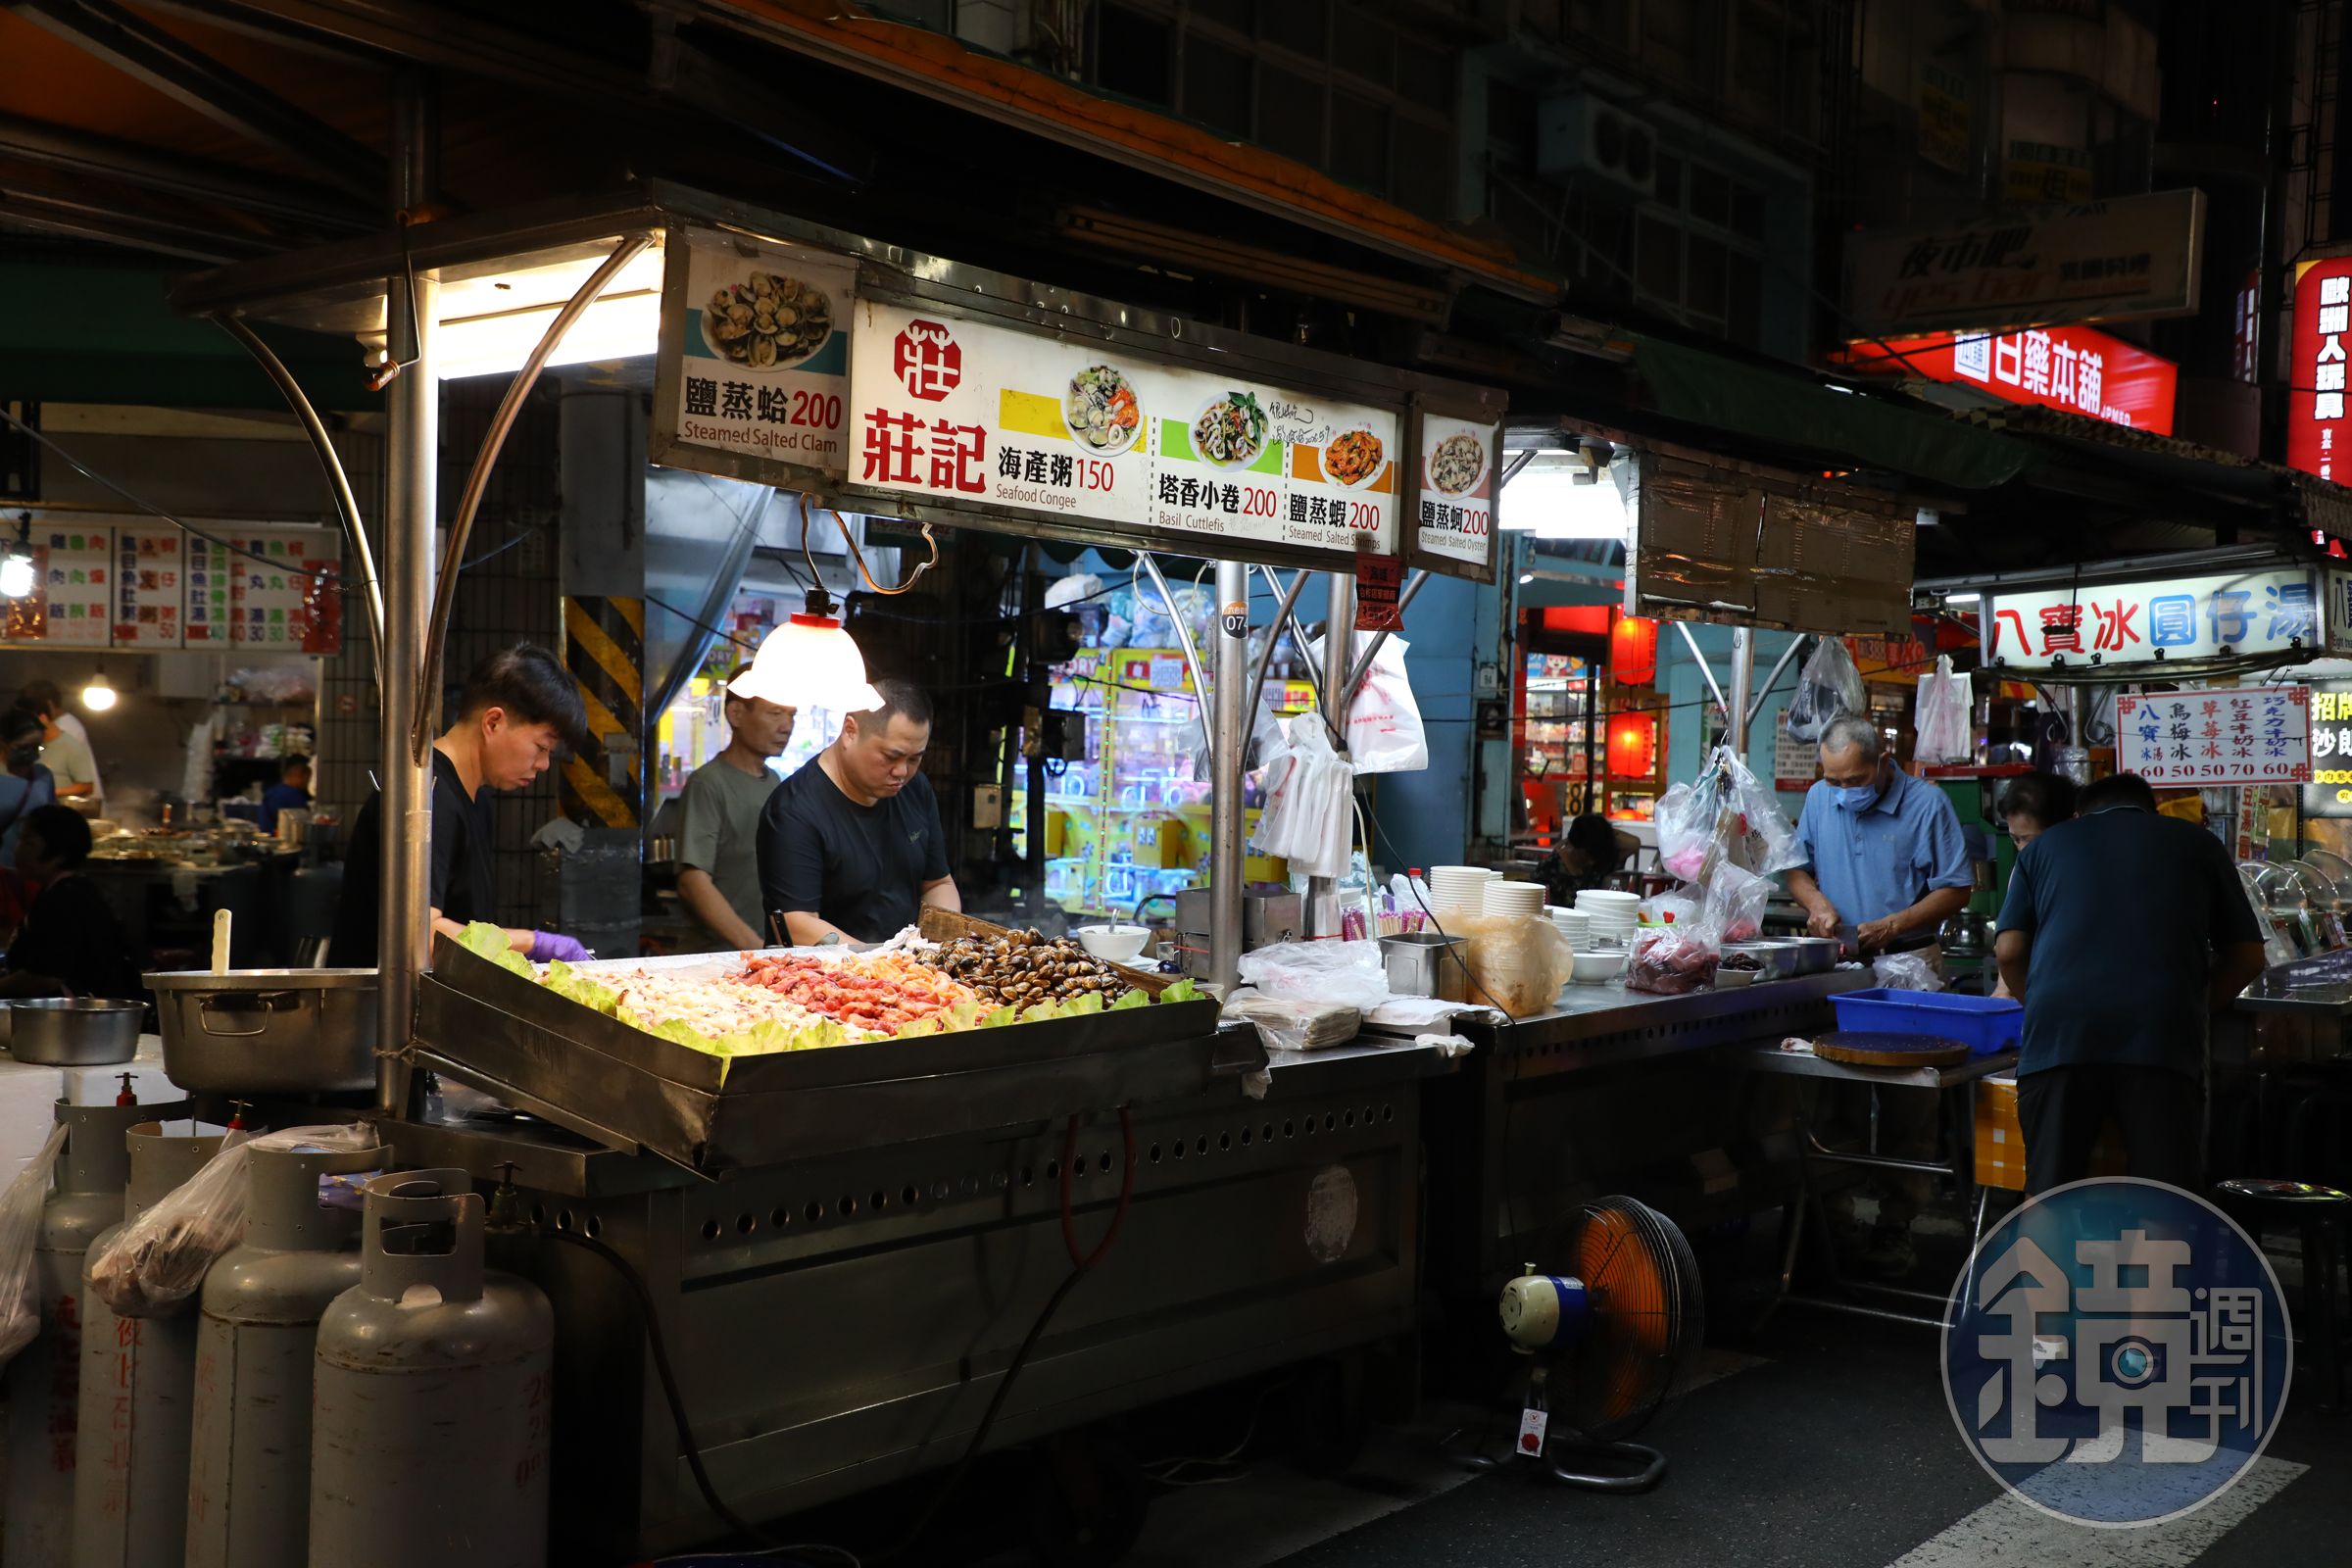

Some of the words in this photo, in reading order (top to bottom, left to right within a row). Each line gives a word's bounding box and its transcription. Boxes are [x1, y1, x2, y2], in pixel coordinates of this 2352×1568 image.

[903, 324, 960, 399] 莊
[2314, 275, 2350, 420] 歐洲人玩具
[685, 376, 788, 424] 鹽蒸蛤
[790, 390, 842, 431] 200
[684, 420, 751, 444] Steamed
[753, 428, 798, 449] Salted
[801, 434, 838, 454] Clam
[862, 408, 988, 494] 莊記
[999, 446, 1073, 488] 海產粥
[1076, 458, 1114, 492] 150
[996, 483, 1037, 503] Seafood
[1039, 489, 1077, 510] Congee
[1158, 472, 1240, 514] 塔香小卷
[1243, 487, 1277, 518] 200
[1289, 493, 1347, 528] 鹽蒸蝦
[1349, 502, 1380, 531] 200
[1421, 500, 1464, 533] 鹽蒸蚵
[1463, 509, 1490, 536] 200
[1158, 511, 1182, 526] Basil
[1185, 514, 1225, 532] Cuttlefis
[1289, 525, 1323, 542] Steamed
[1326, 530, 1349, 546] Salted
[1350, 532, 1381, 551] Shrimps
[1421, 531, 1446, 547] Steamed
[1448, 535, 1467, 549] Salted
[1467, 538, 1487, 553] Oyster
[2169, 703, 2192, 760] 烏梅冰
[2200, 700, 2223, 760] 草莓冰
[2230, 698, 2254, 759] 紅豆牛奶冰
[2263, 696, 2287, 758] 巧克力牛奶冰
[2140, 765, 2165, 778] 60
[2171, 764, 2195, 778] 50
[2201, 764, 2225, 777] 50
[2230, 763, 2255, 776] 70
[2263, 762, 2288, 775] 60
